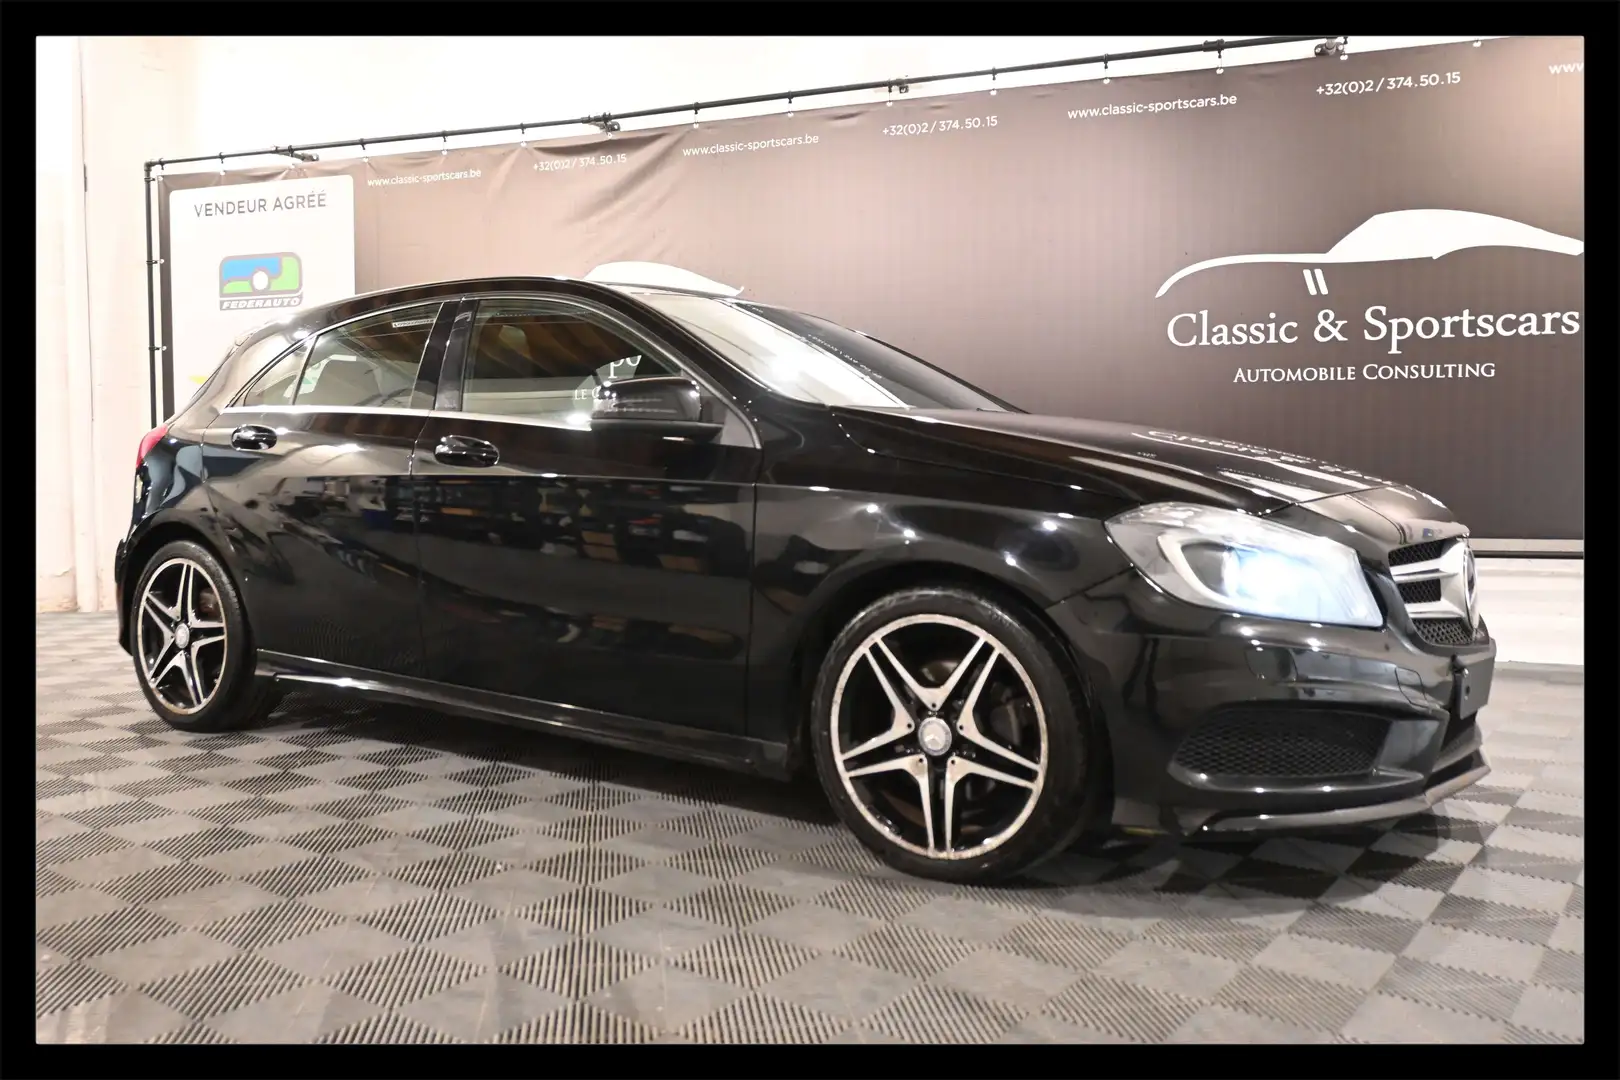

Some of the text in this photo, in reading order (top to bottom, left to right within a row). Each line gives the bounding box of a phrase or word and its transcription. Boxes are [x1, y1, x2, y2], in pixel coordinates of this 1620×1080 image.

[1067, 93, 1238, 120] www.classic-sportscars.be
[682, 133, 820, 157] www.classic-sportscars.be
[367, 168, 482, 187] www.classic-sportscars.be
[194, 190, 327, 218] VENDEUR AGRÉÉ
[221, 297, 301, 310] FEDERAUTO
[1167, 305, 1581, 354] Classic & Sportscars
